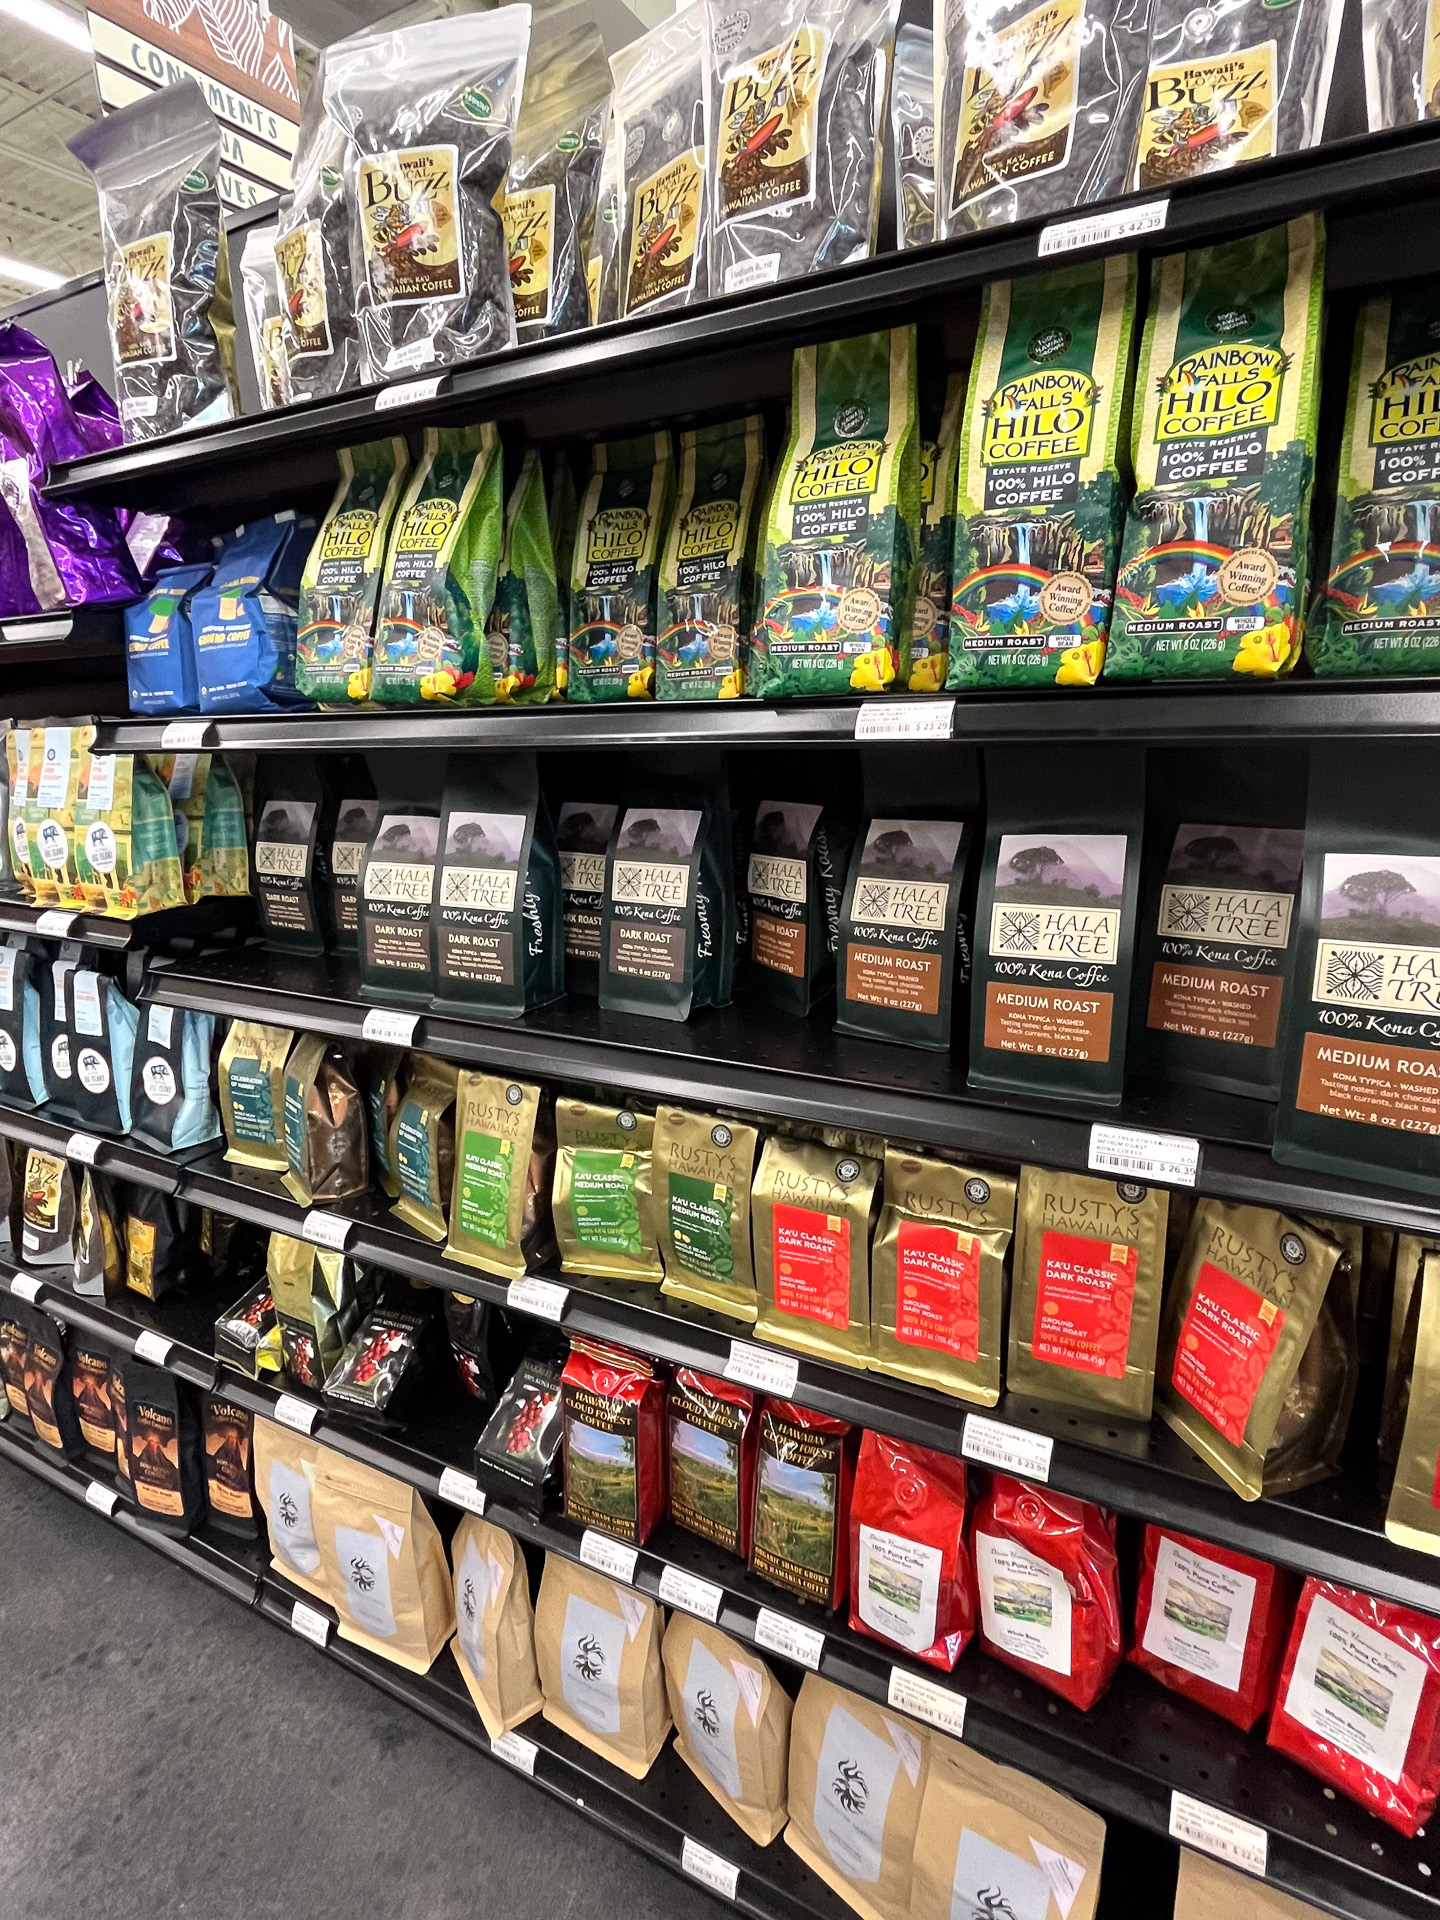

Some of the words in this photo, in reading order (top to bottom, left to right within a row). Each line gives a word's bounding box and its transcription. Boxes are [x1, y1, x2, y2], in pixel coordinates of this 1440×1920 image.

[1183, 61, 1245, 80] Hawaii's
[131, 43, 278, 139] CONIMENTS
[1146, 69, 1268, 114] BUZZ
[398, 157, 434, 171] awaii's
[1012, 151, 1055, 172] COFFEE
[221, 172, 257, 205] VES
[365, 169, 450, 209] BUZZ
[766, 179, 801, 199] COFFEE
[1118, 224, 1125, 235] $
[1128, 218, 1161, 232] 42.39
[422, 280, 453, 292] COFFEE
[1177, 350, 1274, 383] RAINBOW
[1197, 367, 1260, 387] FALLS
[1001, 375, 1086, 407] RAINBOW
[1167, 381, 1272, 415] HILO
[1020, 392, 1072, 411] FALLS
[992, 408, 1084, 439] HILO
[1163, 404, 1267, 434] COFFEE
[989, 436, 1080, 459] COFFEE
[1167, 441, 1205, 450] ESTATE
[1209, 432, 1257, 446] RESERVE
[811, 443, 878, 464] RAINBOW
[1161, 450, 1204, 467] 100%
[1213, 442, 1262, 459] HILO
[1379, 456, 1426, 469] 100%
[800, 458, 874, 483] HILO
[1169, 460, 1248, 480] COFFEE
[797, 477, 870, 498] COFFEE
[988, 478, 1026, 491] 100%
[1033, 473, 1075, 487] HILO
[995, 489, 1063, 506] COFFEE
[795, 512, 826, 524] 100%
[831, 507, 866, 519] HILO
[402, 522, 447, 536] HILO
[684, 522, 733, 542] HILO
[801, 521, 857, 535] COFFEE
[400, 537, 439, 548] COFFEE
[593, 531, 643, 546] HILO
[682, 538, 729, 556] COFFEE
[591, 546, 639, 559] COFFEE
[679, 564, 700, 574] 100%
[703, 561, 725, 570] HILO
[1235, 562, 1266, 572] Award
[1229, 571, 1267, 585] Winning
[1228, 582, 1260, 595] Coffee!
[1128, 623, 1177, 633] MEDIUM
[1181, 621, 1220, 630] ROAST
[1344, 621, 1394, 632] MEDIUM
[771, 644, 805, 653] MEDIUM
[1156, 640, 1170, 651] NET
[1172, 639, 1182, 650] WT
[1183, 639, 1188, 649] 8
[1189, 639, 1200, 649] OZ
[1201, 638, 1216, 651] (226
[1217, 638, 1225, 651] g)
[472, 874, 510, 888] HALA
[770, 863, 803, 879] HALA
[471, 888, 510, 907] TREE
[770, 878, 802, 897] TREE
[893, 886, 939, 904] HALA
[890, 903, 938, 924] TREE
[1215, 896, 1282, 917] HALA
[1046, 912, 1110, 933] HALA
[1212, 915, 1280, 941] TREE
[449, 934, 470, 944] DARK
[473, 937, 500, 948] ROAST
[1043, 933, 1108, 958] TREE
[895, 957, 931, 972] ROAST
[994, 961, 1027, 975] 100%
[1029, 963, 1065, 981] Kona
[1066, 965, 1109, 987] Coffee
[996, 992, 1049, 1009] MEDIUM
[1053, 997, 1100, 1014] ROAST
[1008, 1012, 1026, 1021] KONA
[1028, 1014, 1051, 1023] TYPICA
[1057, 1017, 1084, 1027] WASHED
[1318, 1009, 1362, 1029] 100%
[1366, 1014, 1417, 1038] Kona
[1001, 1040, 1016, 1050] Net
[1018, 1042, 1034, 1051] Wt:
[1036, 1044, 1043, 1052] 8
[1045, 1046, 1056, 1055] oz
[1058, 1046, 1088, 1060] (227g)
[1317, 1047, 1391, 1071] MEDIUM
[1332, 1072, 1357, 1082] KONA
[1359, 1076, 1391, 1089] TYPICA
[1400, 1082, 1438, 1095] WASHED
[1329, 1089, 1352, 1101] black
[1395, 1100, 1420, 1111] black
[1422, 1105, 1436, 1114] tea
[1380, 1089, 1400, 1100] dark
[468, 1101, 520, 1125] RUSTY'S
[1320, 1103, 1341, 1117] Net
[1343, 1108, 1365, 1121] Wt:
[1369, 1111, 1377, 1123] 8
[1381, 1115, 1396, 1126] oz
[670, 1143, 737, 1170] RUSTY'S
[669, 1159, 736, 1182] HAWAIIAN
[574, 1181, 603, 1189] MEDIUM
[774, 1170, 849, 1201] RUSTY'S
[771, 1188, 848, 1213] HAWAIIAN
[1044, 1193, 1140, 1225] RUSTY'S
[1042, 1212, 1139, 1241] HAWAIIAN
[1211, 1226, 1297, 1294] RUSTY'S
[1046, 1260, 1071, 1270] KA'U
[1073, 1264, 1117, 1281] CLASSIC
[1046, 1270, 1074, 1282] DARK
[1076, 1276, 1112, 1290] ROAST
[1041, 1316, 1074, 1328] GROUND
[137, 1404, 172, 1424] Volcano
[565, 1399, 594, 1416] CLOUD
[580, 1414, 614, 1431] COFFEE
[686, 1413, 720, 1433] COFFEE
[778, 1424, 825, 1446] HAWAIIAN
[799, 1444, 835, 1460] FOREST
